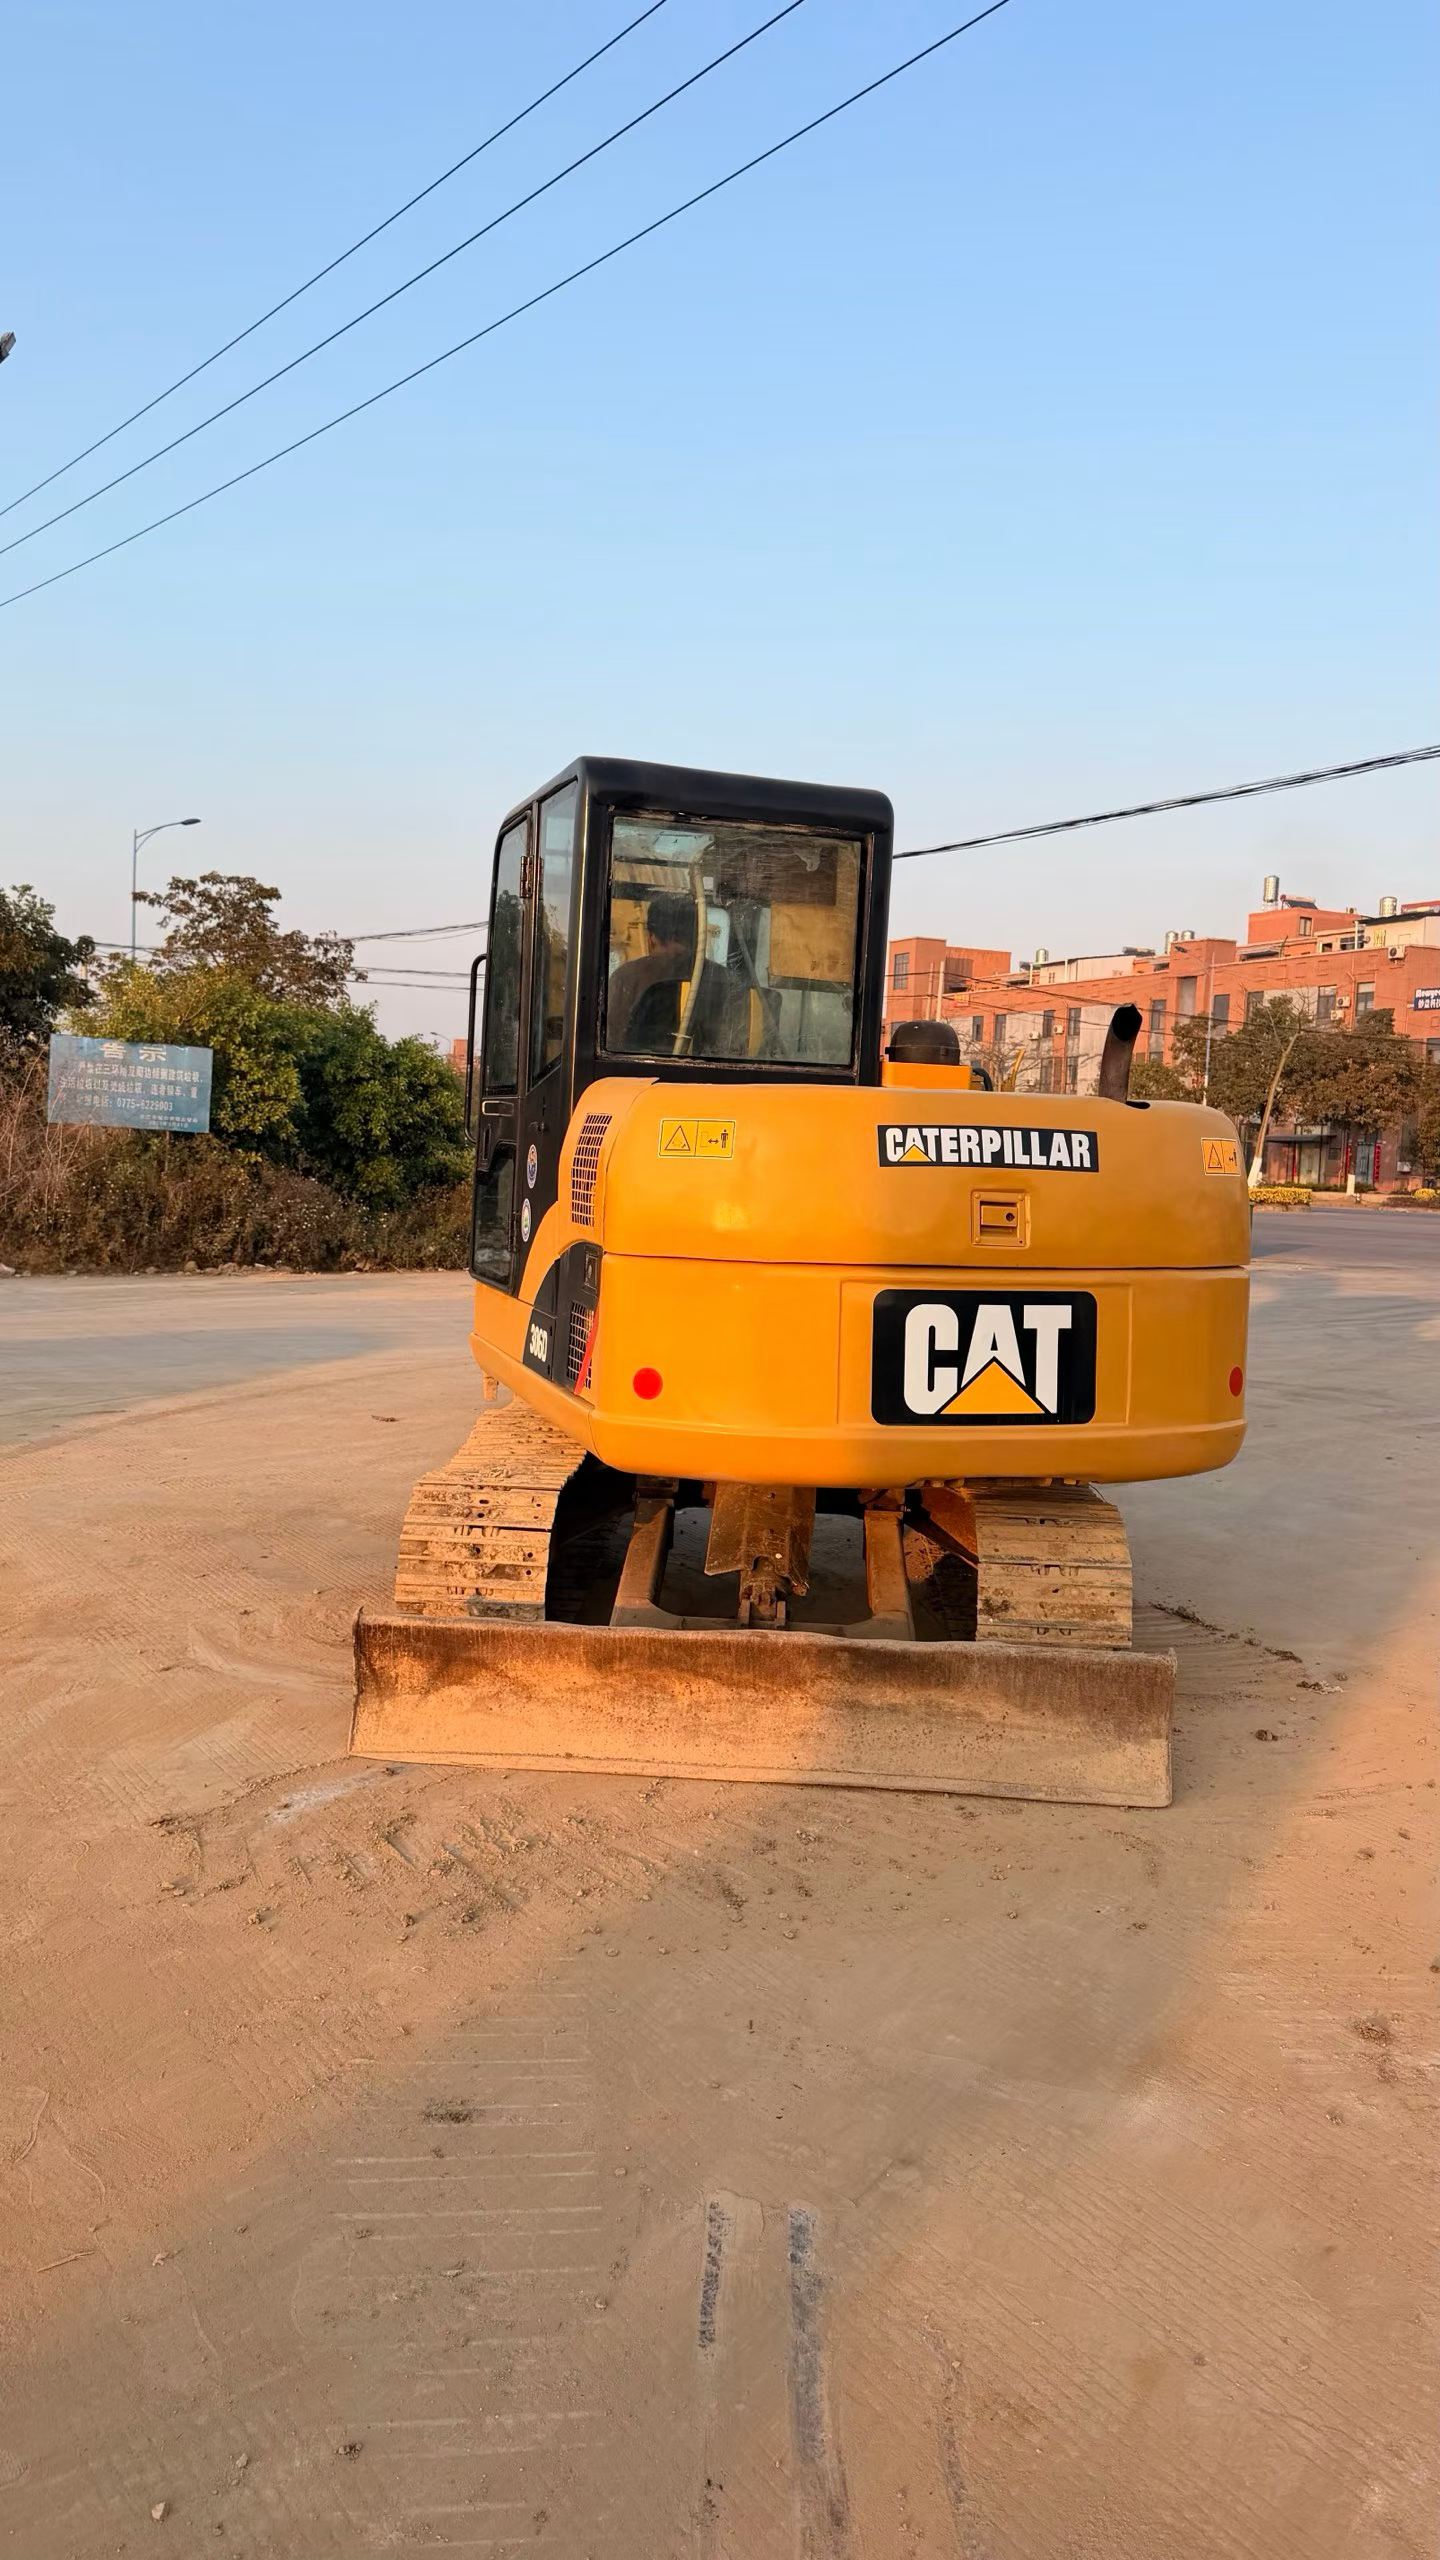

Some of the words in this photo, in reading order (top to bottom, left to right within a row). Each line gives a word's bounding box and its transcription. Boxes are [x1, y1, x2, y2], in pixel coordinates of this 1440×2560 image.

[886, 1127, 1091, 1168] CATERPILLAR
[529, 1323, 548, 1363] 306D
[903, 1303, 1073, 1415] CAT
